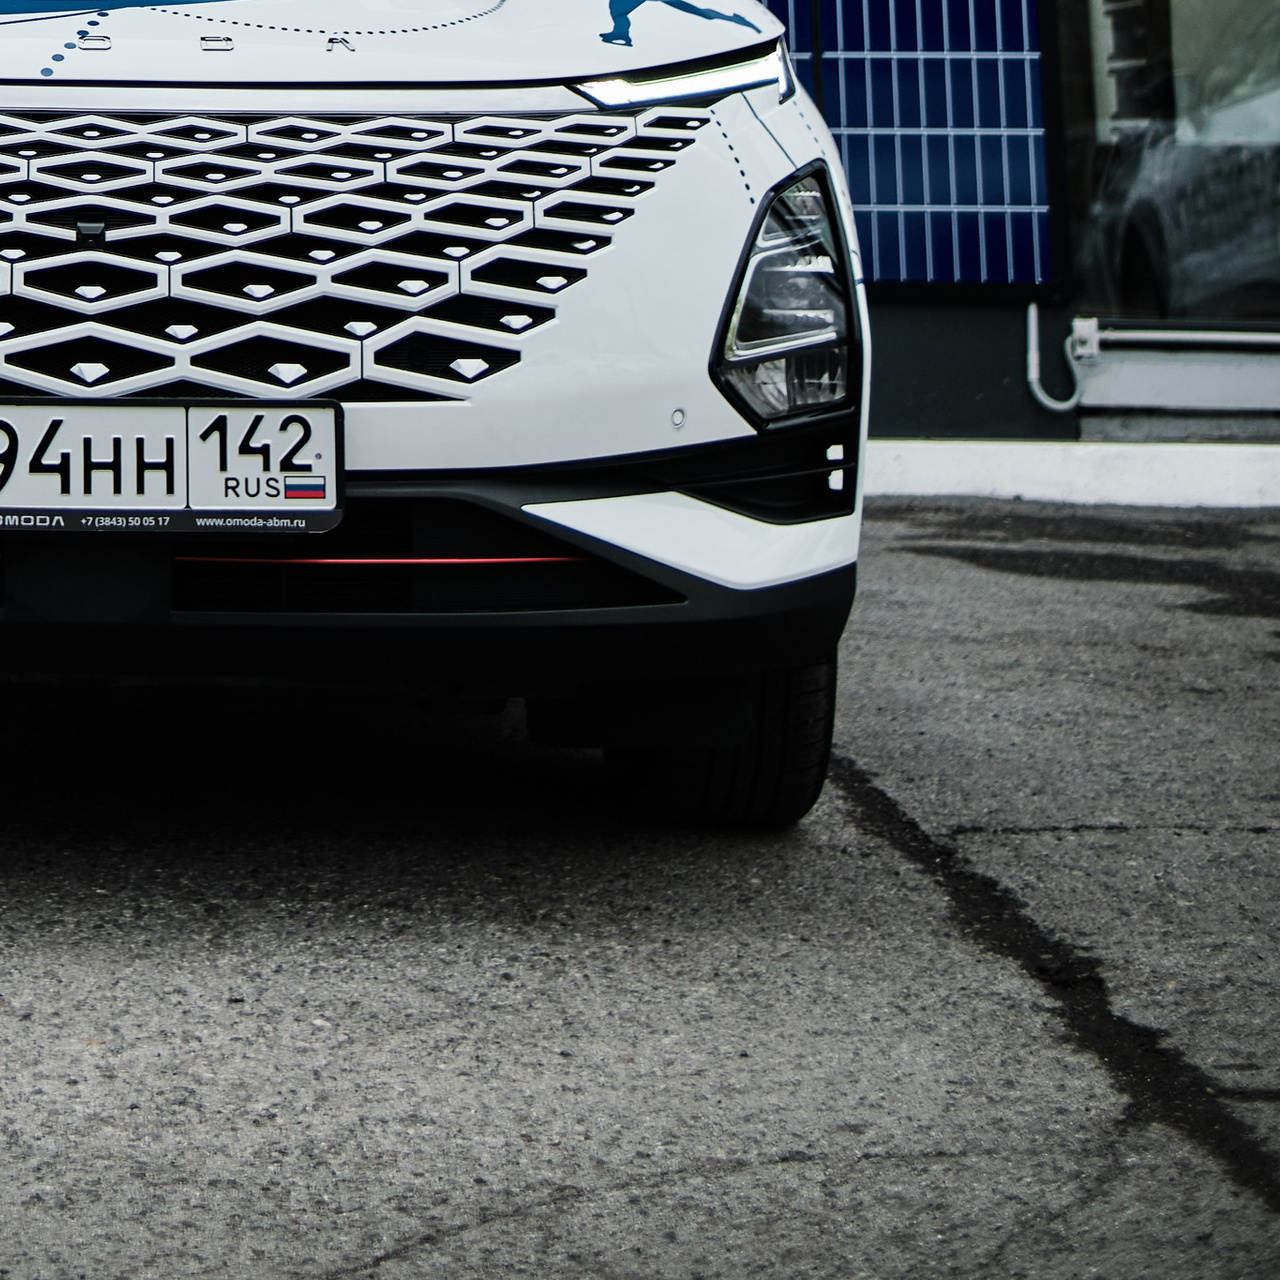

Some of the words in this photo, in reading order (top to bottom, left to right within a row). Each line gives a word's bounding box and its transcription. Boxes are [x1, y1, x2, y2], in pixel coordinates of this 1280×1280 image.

[199, 414, 313, 473] 142
[224, 477, 281, 498] RUS
[80, 516, 93, 526] +7
[94, 516, 127, 528] (3843)
[128, 516, 141, 527] 50
[142, 516, 156, 527] 05
[158, 516, 170, 527] 17
[195, 517, 306, 528] www.omoda-abm.ru
